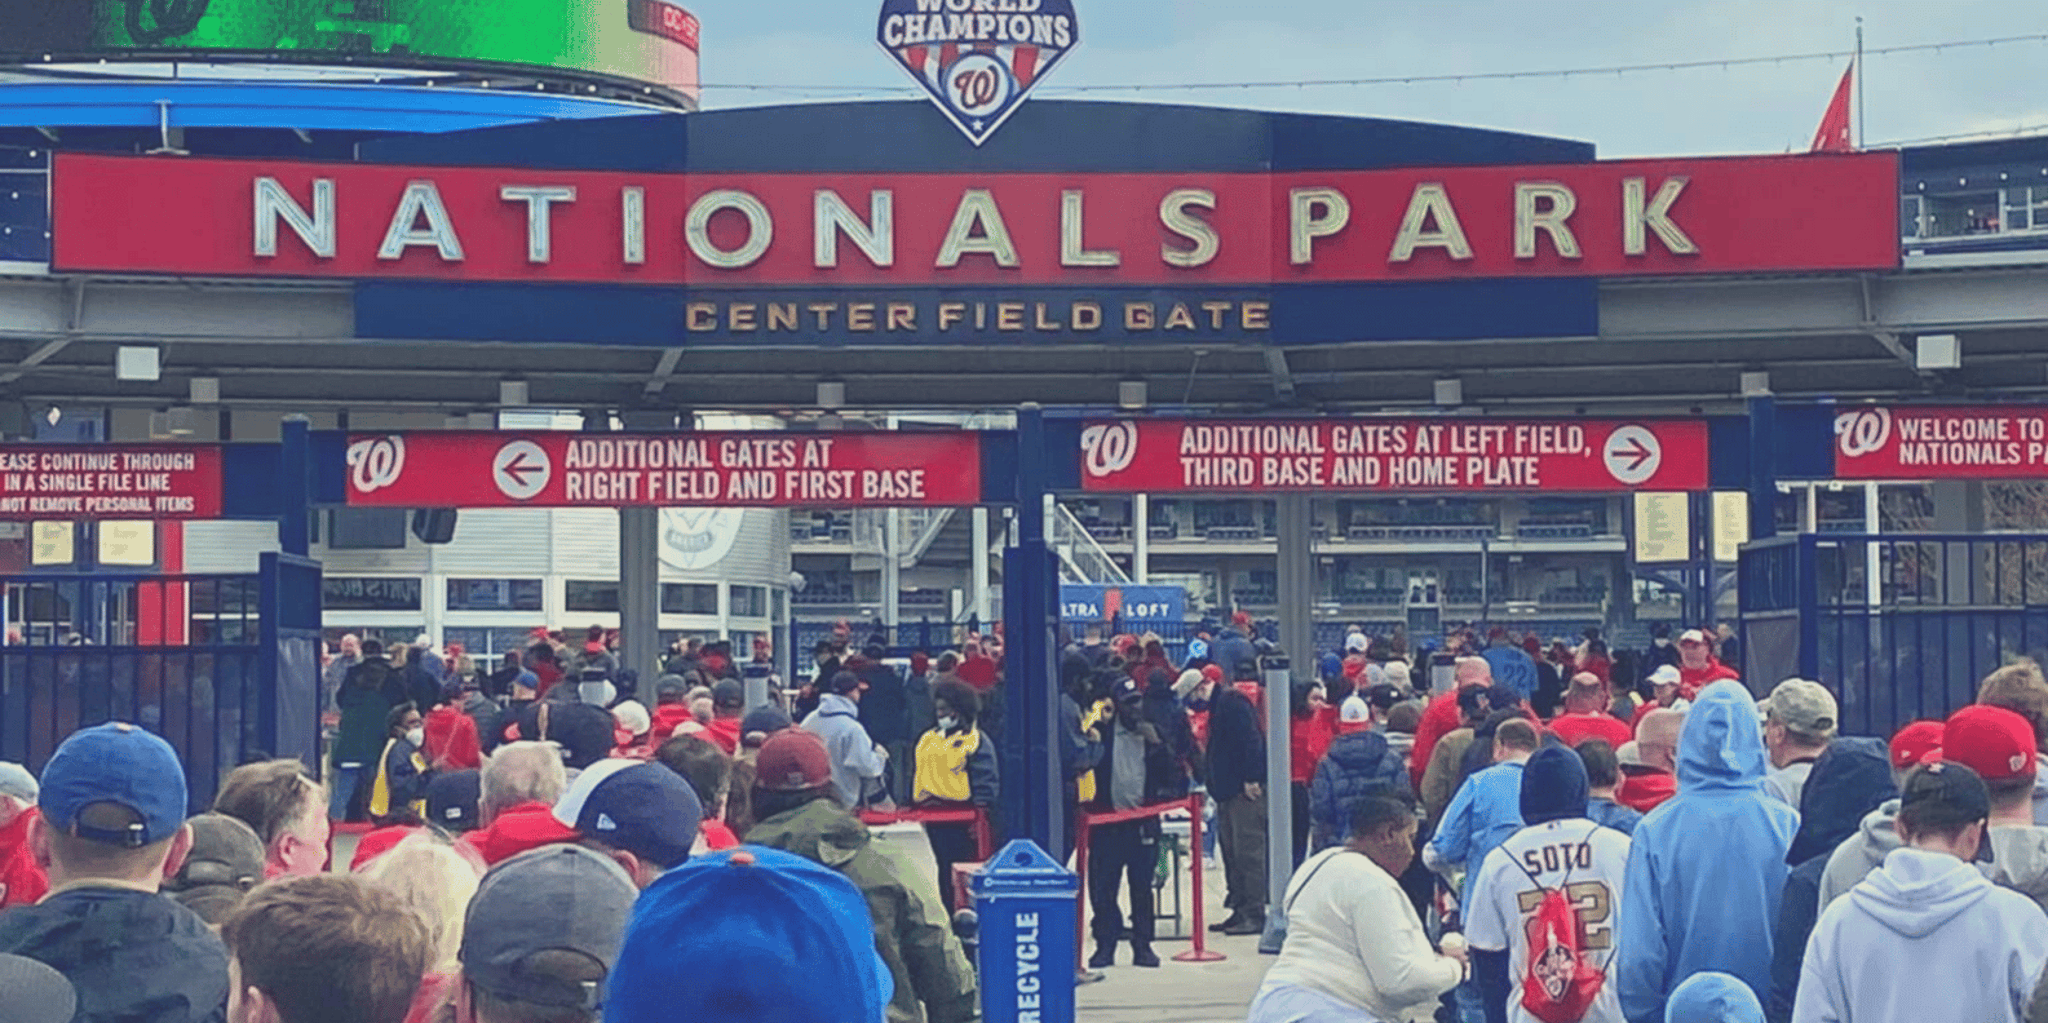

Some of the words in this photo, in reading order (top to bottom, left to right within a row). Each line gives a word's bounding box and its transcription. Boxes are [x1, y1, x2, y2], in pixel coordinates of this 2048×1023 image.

[884, 13, 1071, 47] CHAMPIONS
[252, 176, 1220, 268] NATIONALS
[1289, 176, 1699, 265] PARK
[685, 302, 917, 331] CENTER
[938, 302, 1101, 330] FIELD
[1124, 302, 1271, 330] GATE
[1180, 426, 1325, 454] ADDITIONAL
[1332, 426, 1407, 454] GATES
[1414, 426, 1443, 454] AT
[1450, 426, 1507, 454] LEFT
[1515, 425, 1591, 458] FIELD,
[1899, 418, 2010, 440] WELCOME
[2017, 418, 2044, 441] TO
[41, 453, 118, 470] CONTINUE
[123, 453, 194, 471] THROUGH
[565, 440, 713, 468] ADDITIONAL
[721, 440, 796, 467] GATES
[803, 440, 833, 468] AT
[1899, 443, 2021, 465] NATIONALS
[4, 474, 20, 491] IN
[24, 474, 36, 491] A
[39, 473, 94, 491] SINGLE
[98, 473, 132, 491] FILE
[136, 473, 170, 491] LINE
[566, 471, 641, 499] RIGHT
[649, 471, 720, 499] FIELD
[727, 471, 777, 499] AND
[785, 470, 855, 498] FIRST
[863, 470, 925, 498] BASE
[1180, 457, 1254, 485] THIRD
[1263, 457, 1325, 485] BASE
[1331, 457, 1381, 485] AND
[1389, 457, 1459, 485] HOME
[1466, 457, 1540, 485] PLATE
[29, 497, 81, 511] REMOVE
[85, 497, 152, 512] PERSONAL
[156, 497, 194, 511] ITEMS
[1126, 603, 1169, 617] LOFT
[1524, 842, 1593, 876] SOTO
[1015, 911, 1041, 1023] RECYCLE
